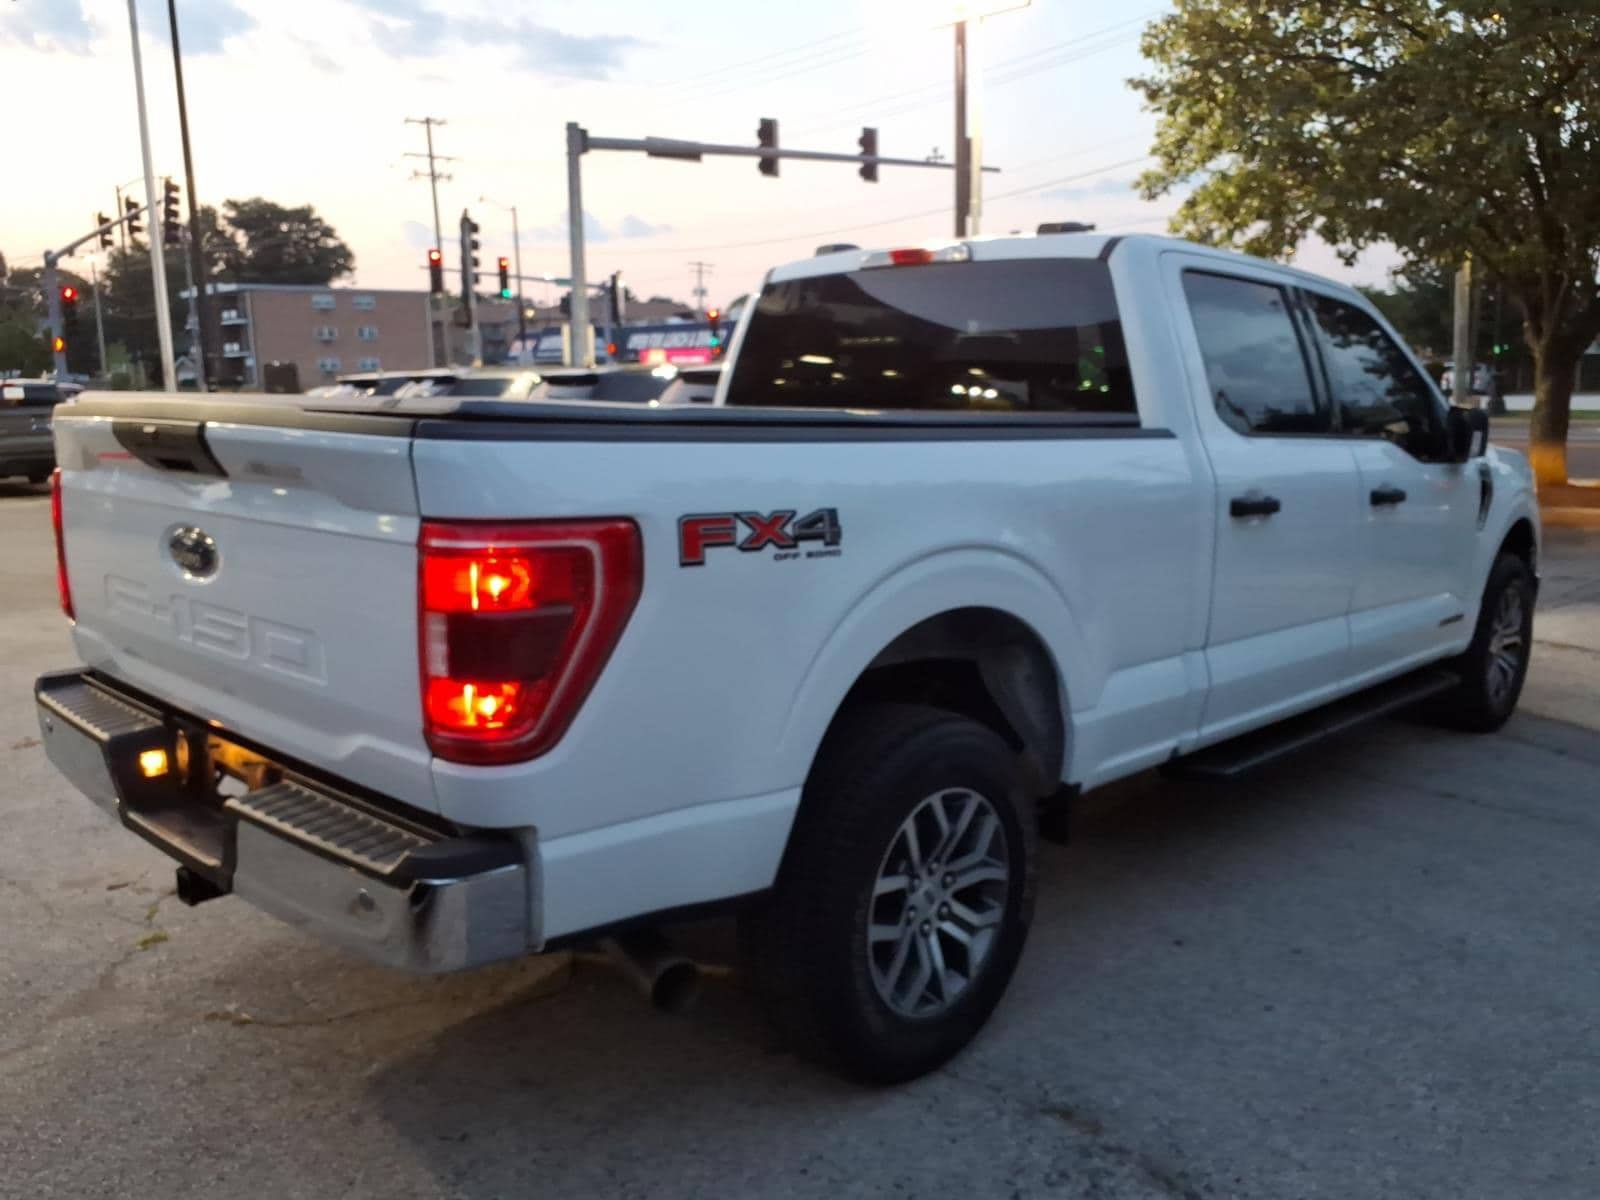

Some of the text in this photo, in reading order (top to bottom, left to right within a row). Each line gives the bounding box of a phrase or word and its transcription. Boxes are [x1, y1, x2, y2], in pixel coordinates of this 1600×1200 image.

[677, 507, 843, 568] FX4
[773, 551, 801, 562] OFF
[103, 573, 328, 687] F-150
